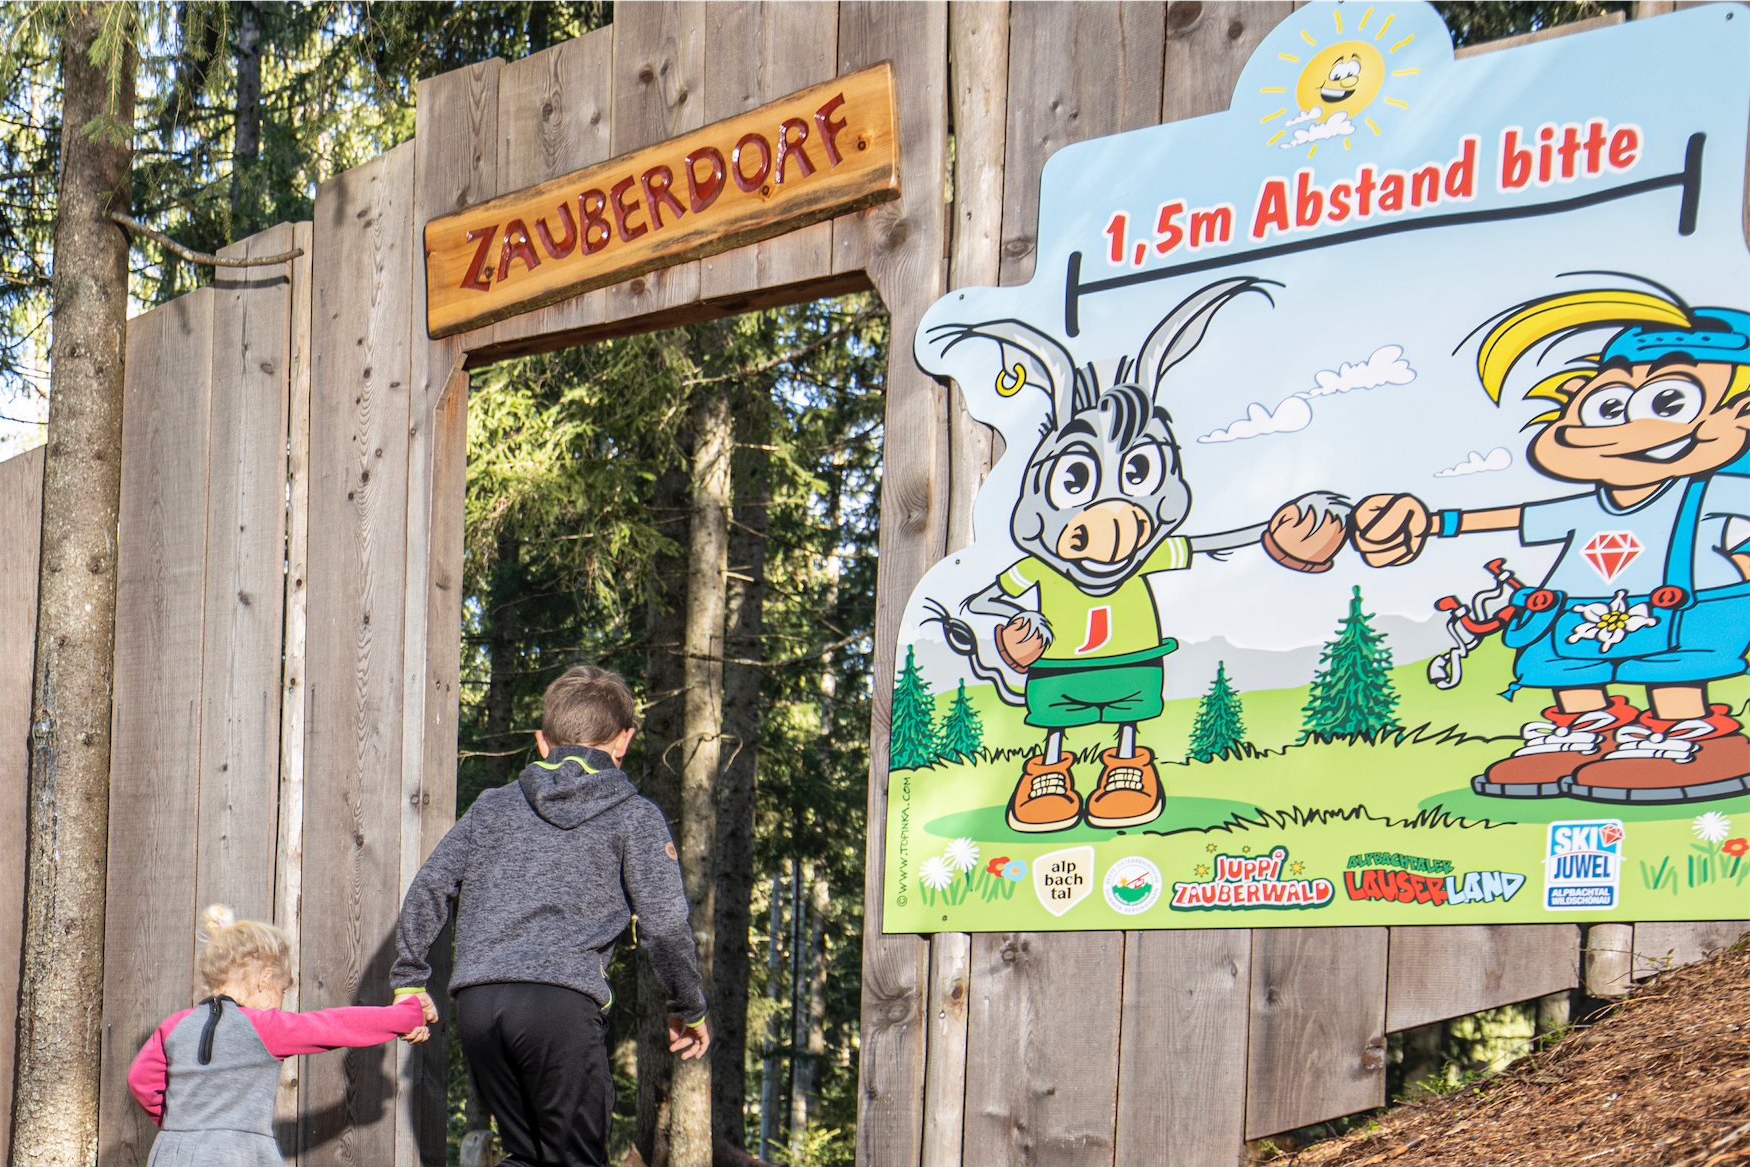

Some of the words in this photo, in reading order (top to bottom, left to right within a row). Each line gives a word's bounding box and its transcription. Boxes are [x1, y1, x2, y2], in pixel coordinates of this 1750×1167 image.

[458, 91, 848, 293] ZAUBERDORF
[1105, 203, 1231, 267] 1,5m
[1251, 138, 1476, 239] Abstand
[1499, 121, 1640, 189] bitte
[1553, 826, 1599, 854] SKI
[1051, 860, 1077, 874] alp
[1347, 851, 1455, 875] ALPBACHTALER
[1553, 854, 1611, 879] JUWEL
[1044, 873, 1084, 886] bach
[1050, 887, 1072, 900] tal
[1174, 881, 1331, 904] ZAUBERWALD
[1550, 888, 1611, 897] ALPBACHTAL
